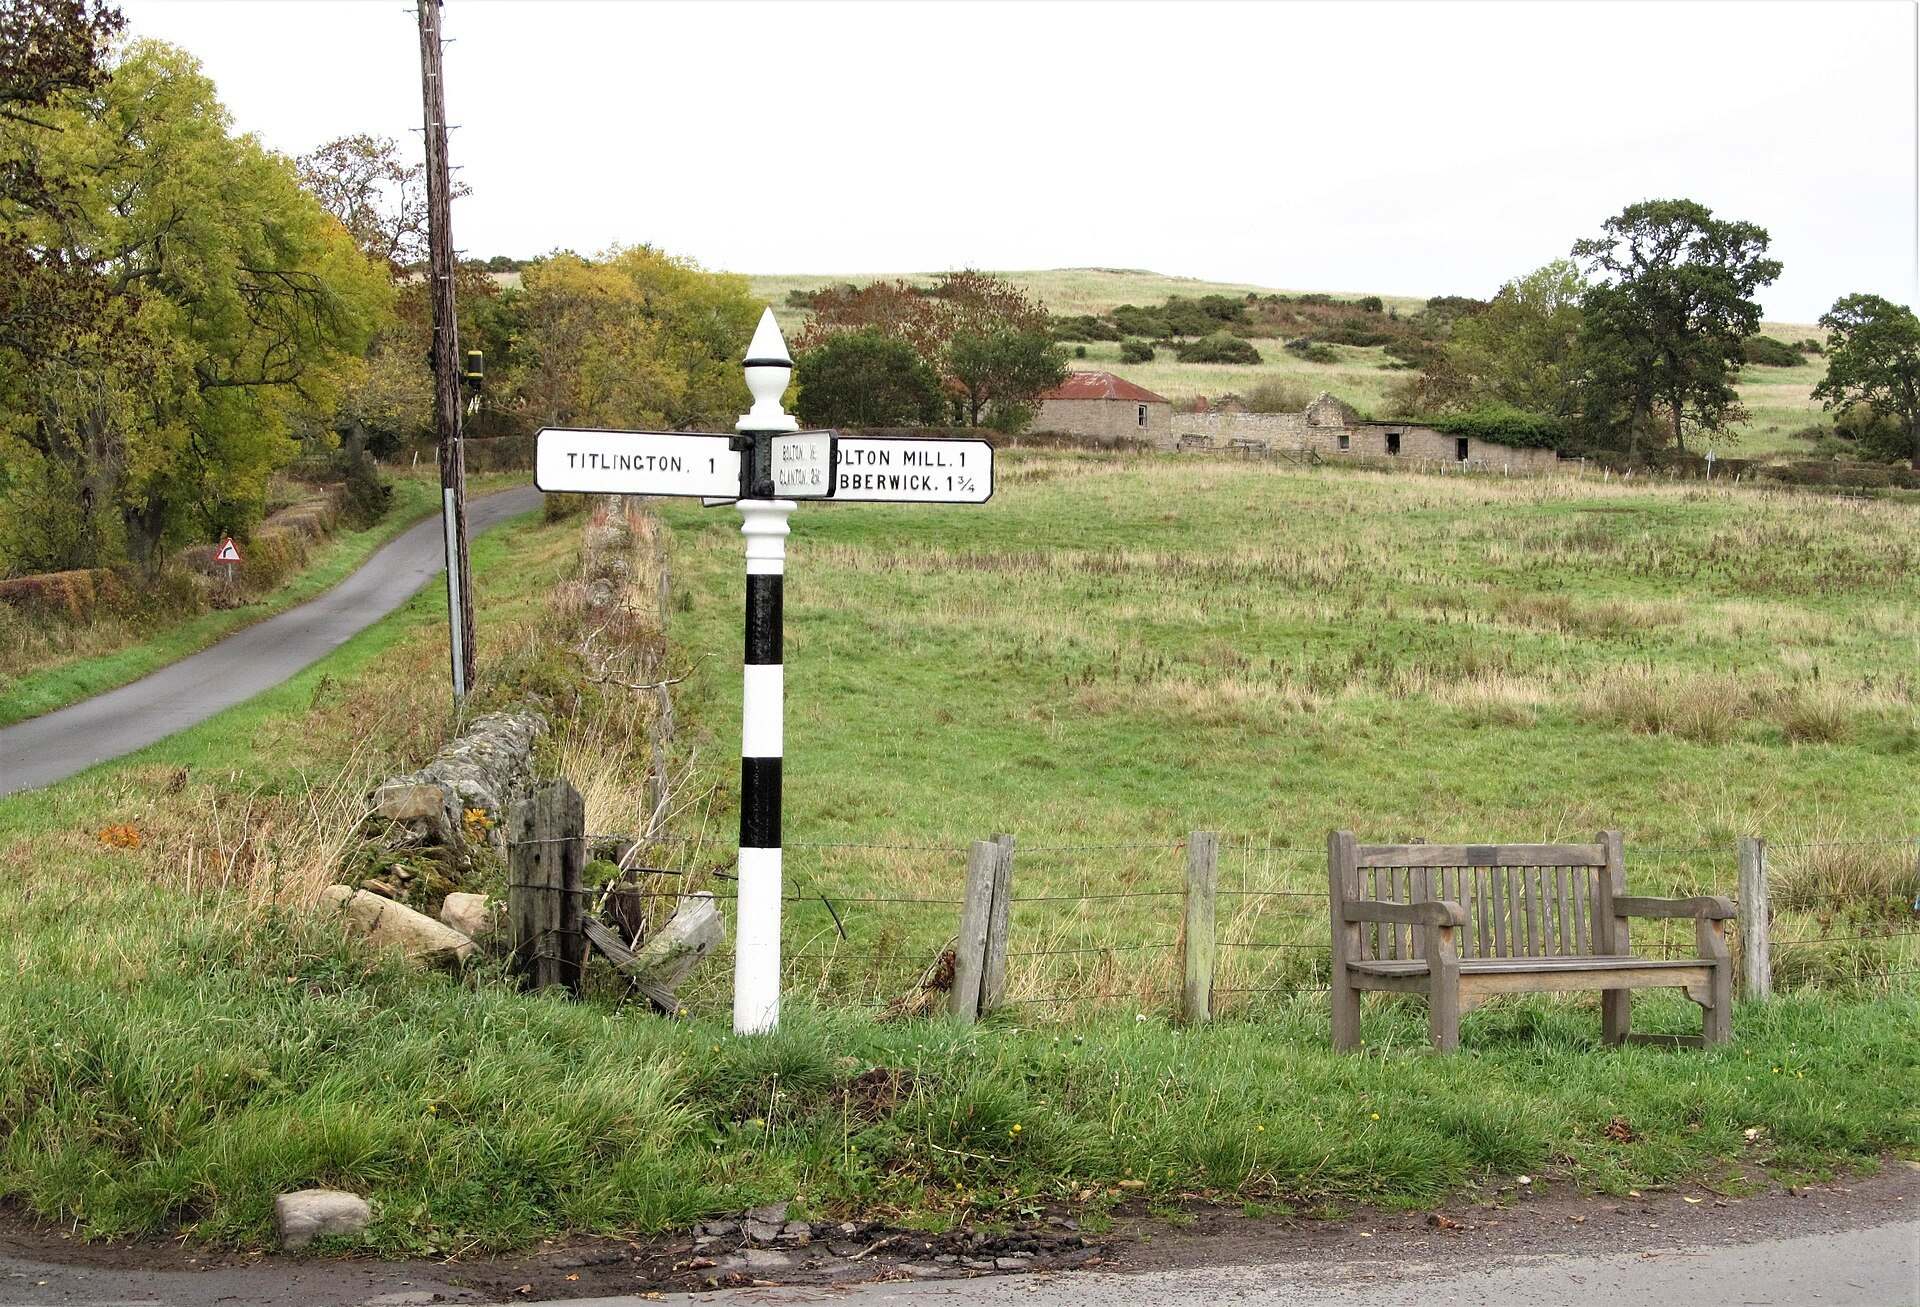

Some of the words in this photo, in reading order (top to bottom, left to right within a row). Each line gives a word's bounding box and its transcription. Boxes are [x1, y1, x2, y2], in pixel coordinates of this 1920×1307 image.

[709, 457, 715, 475] 1
[837, 449, 890, 466] OLTON
[903, 450, 953, 467] MILL.
[959, 451, 965, 468] 1
[839, 473, 939, 492] BBERWICK.
